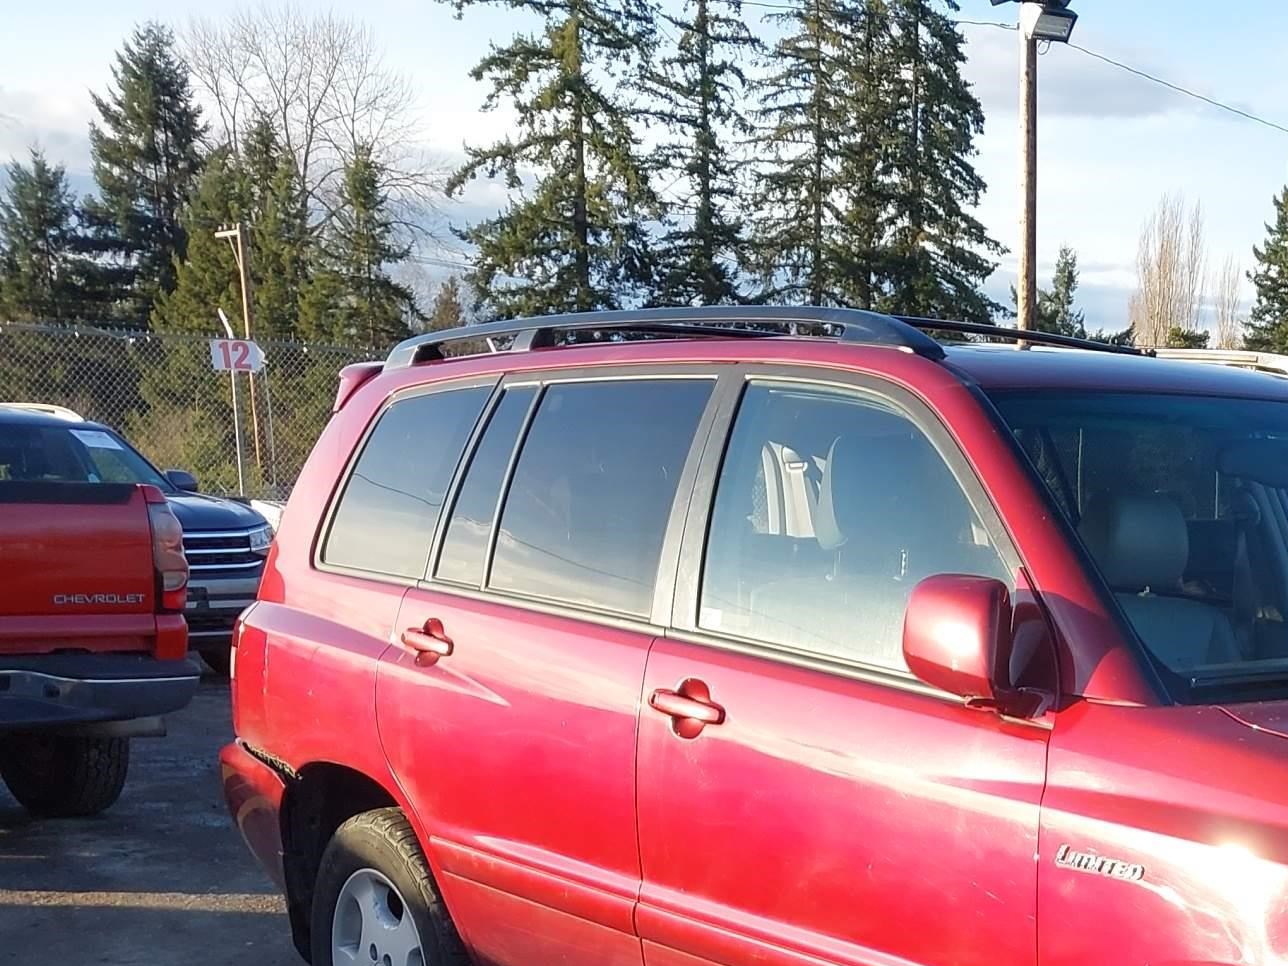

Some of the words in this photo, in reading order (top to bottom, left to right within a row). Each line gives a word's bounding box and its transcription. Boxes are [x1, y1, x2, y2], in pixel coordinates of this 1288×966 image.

[218, 340, 252, 369] 12
[54, 593, 145, 604] CHEVROLET
[1056, 843, 1145, 880] LIMITED
